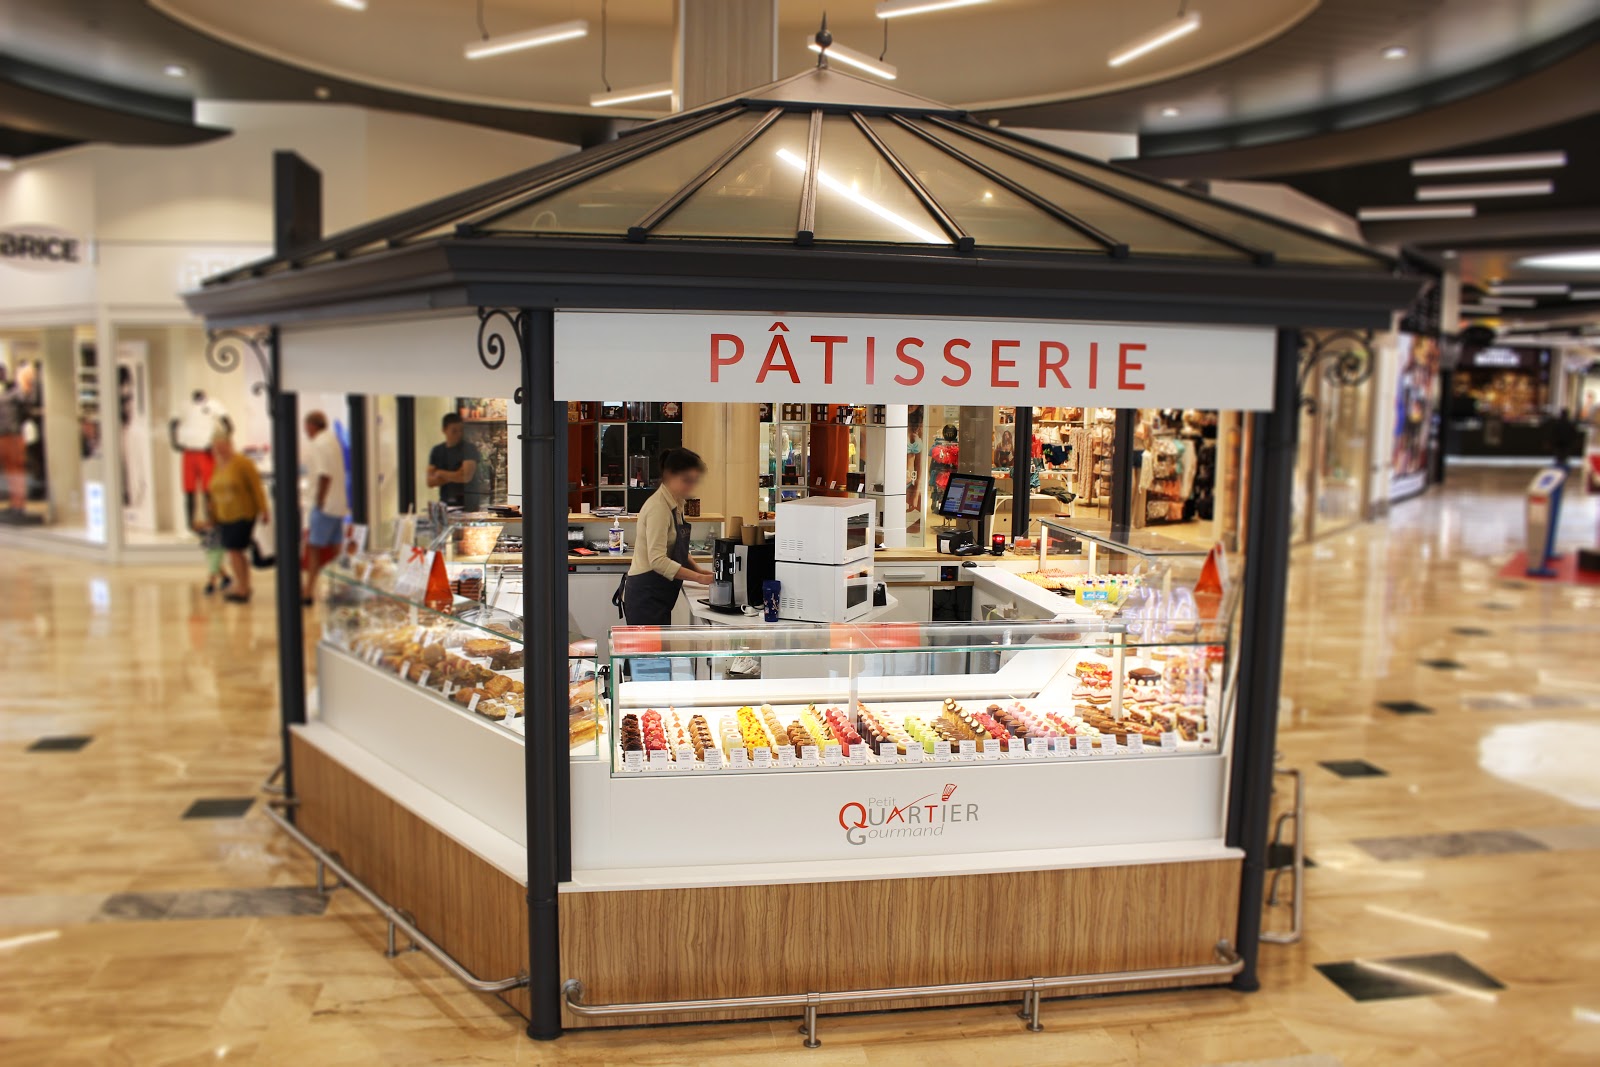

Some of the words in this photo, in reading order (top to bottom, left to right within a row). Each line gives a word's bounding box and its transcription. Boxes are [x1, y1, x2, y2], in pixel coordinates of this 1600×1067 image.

[710, 321, 1147, 391] PÂTISSERIE
[868, 797, 898, 807] Petit
[839, 801, 979, 830] QUARTIER
[846, 824, 945, 845] Gourmand
